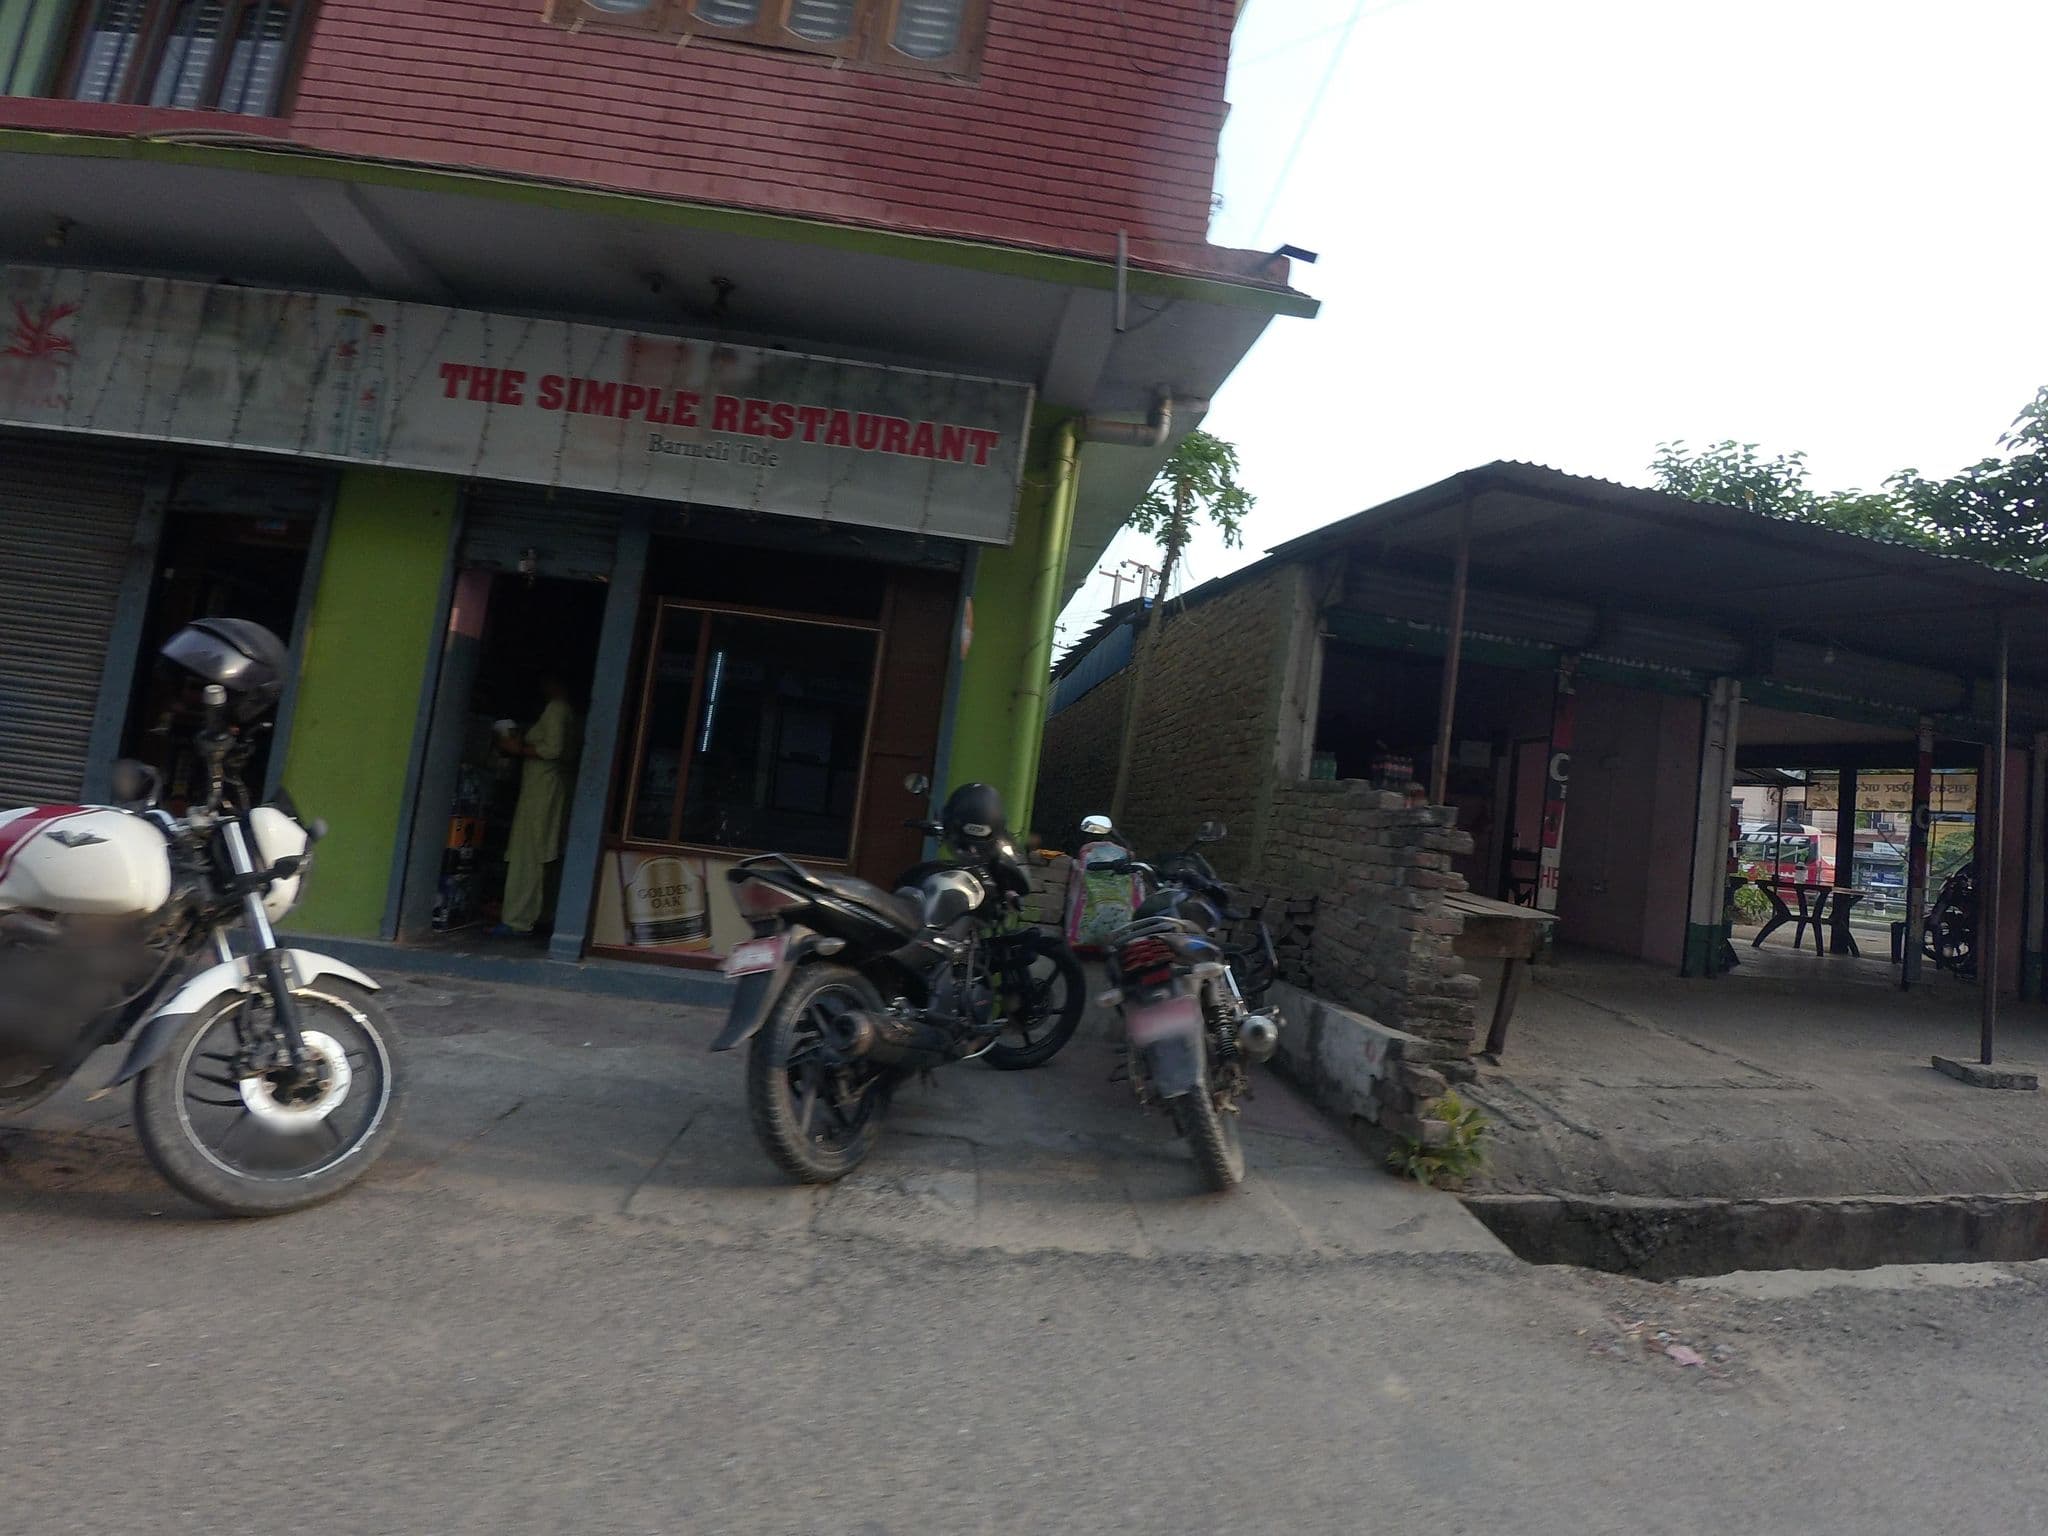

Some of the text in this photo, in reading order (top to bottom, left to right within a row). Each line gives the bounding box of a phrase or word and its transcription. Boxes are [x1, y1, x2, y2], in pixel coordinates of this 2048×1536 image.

[440, 362, 999, 466] THE SIMPLE RESTAURANT
[651, 896, 681, 909] OAK
